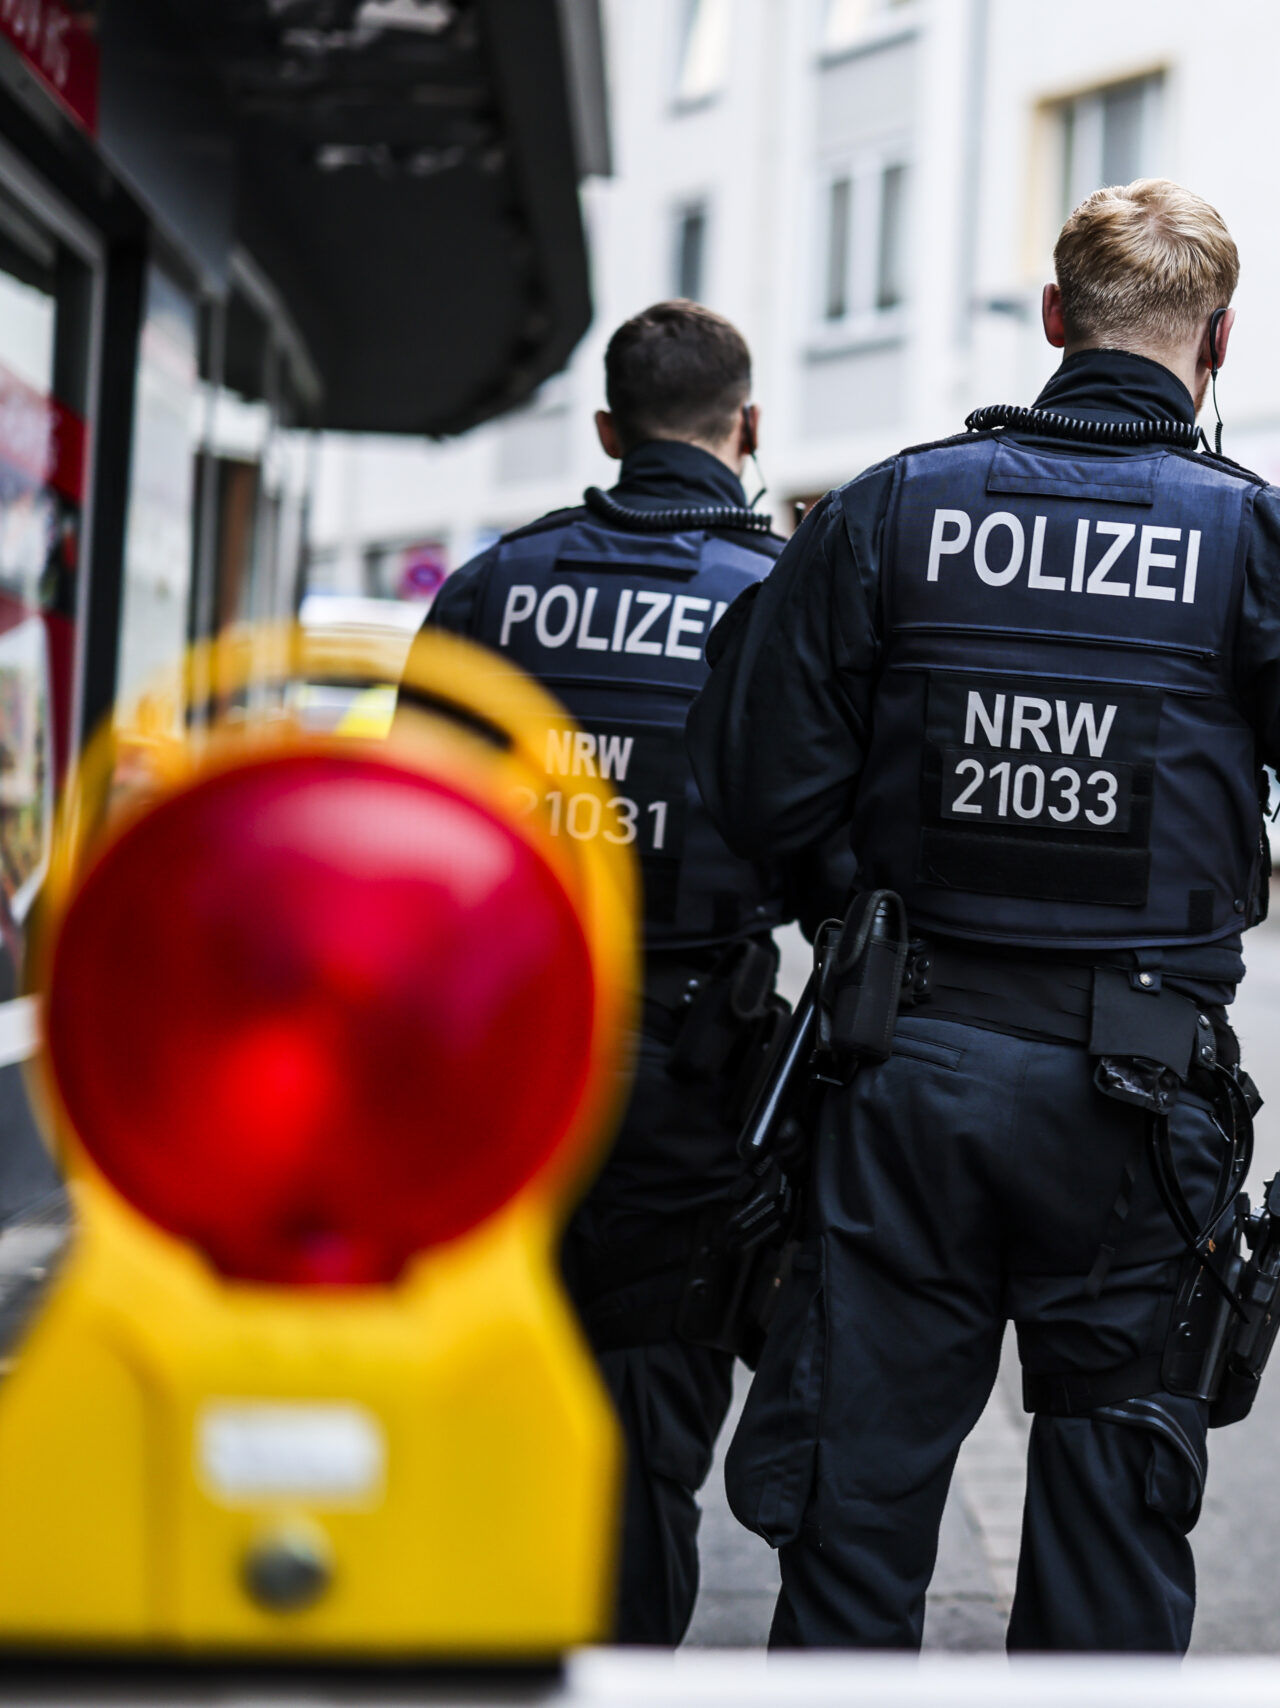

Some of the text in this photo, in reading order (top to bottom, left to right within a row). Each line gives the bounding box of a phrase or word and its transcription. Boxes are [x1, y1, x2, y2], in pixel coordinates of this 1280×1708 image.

[927, 508, 1202, 604] POLIZEI
[545, 728, 634, 781] NRW
[963, 690, 1118, 758] NRW
[951, 758, 1119, 826] 21033
